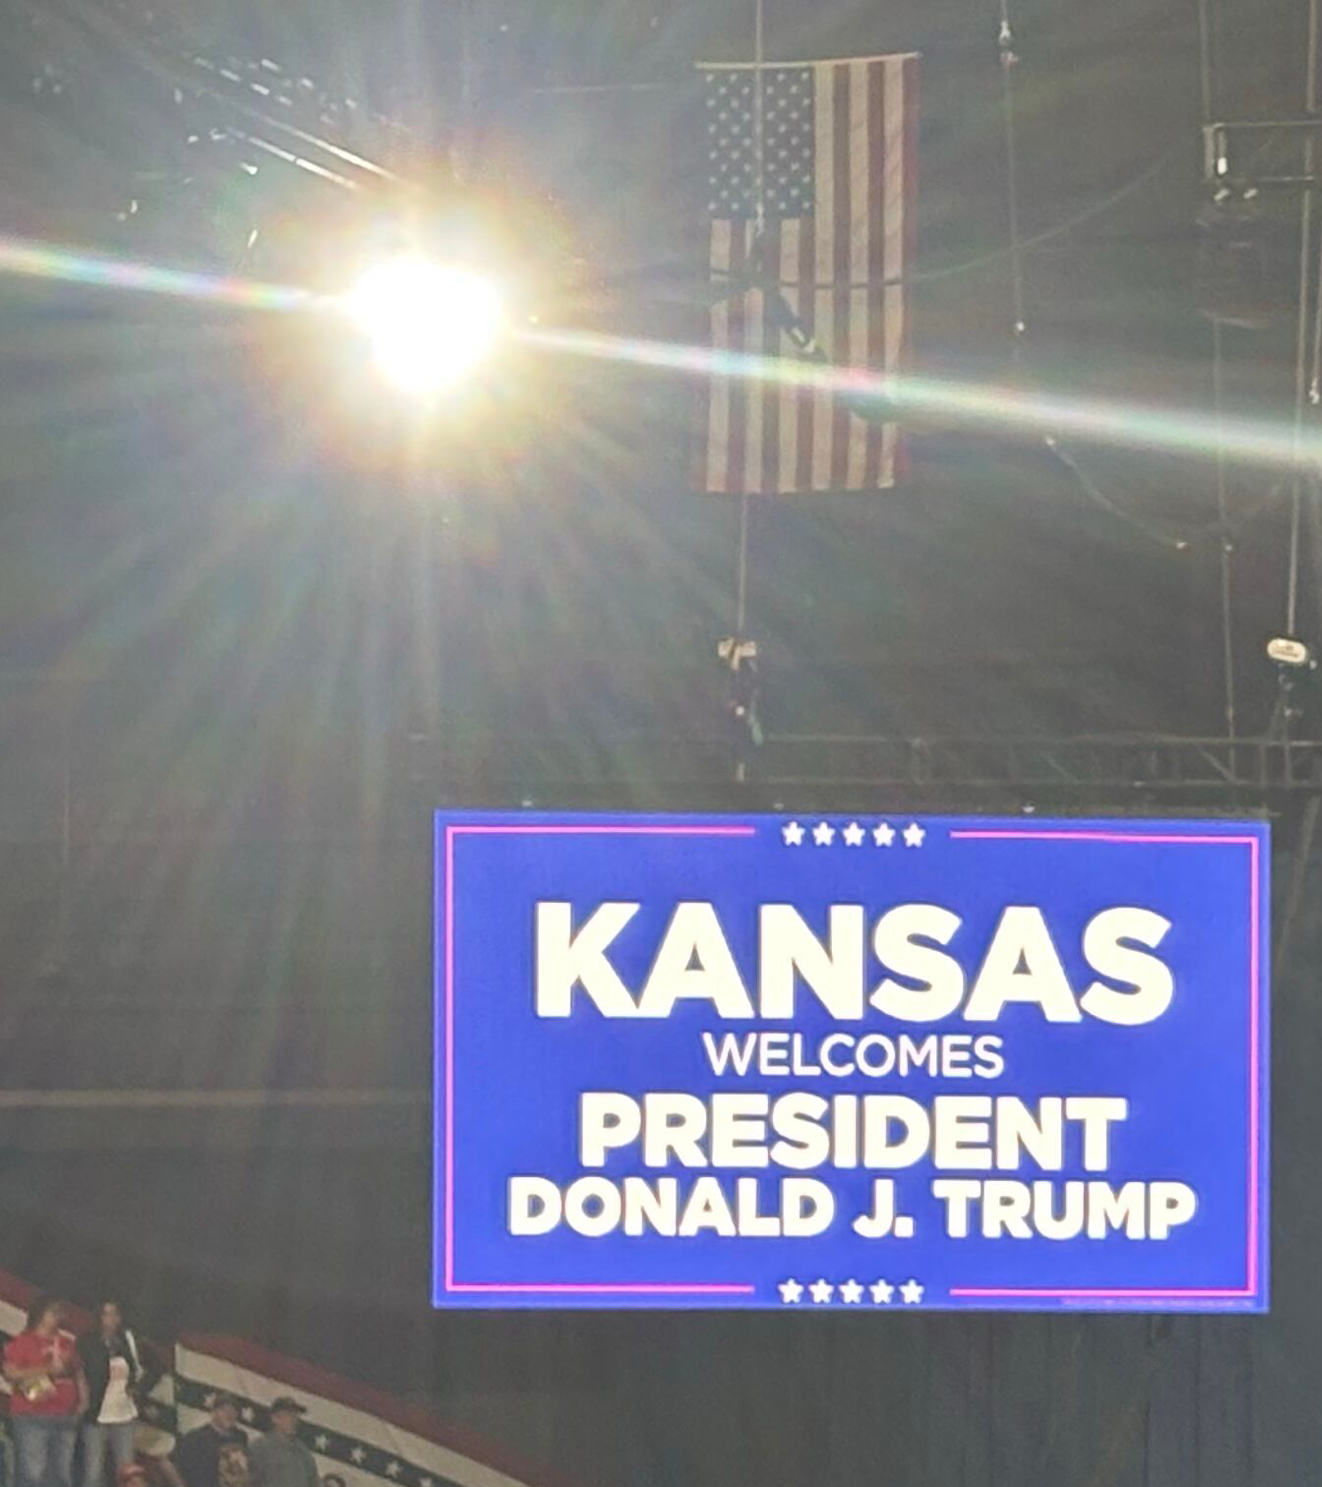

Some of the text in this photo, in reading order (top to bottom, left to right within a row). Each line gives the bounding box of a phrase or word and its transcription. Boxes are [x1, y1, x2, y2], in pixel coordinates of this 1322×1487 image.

[535, 901, 1174, 1025] KANSAS
[702, 1032, 1005, 1078] WELCOMES
[579, 1092, 1127, 1172] PRESIDENT
[507, 1175, 1197, 1241] DONALD J. TRUMP
